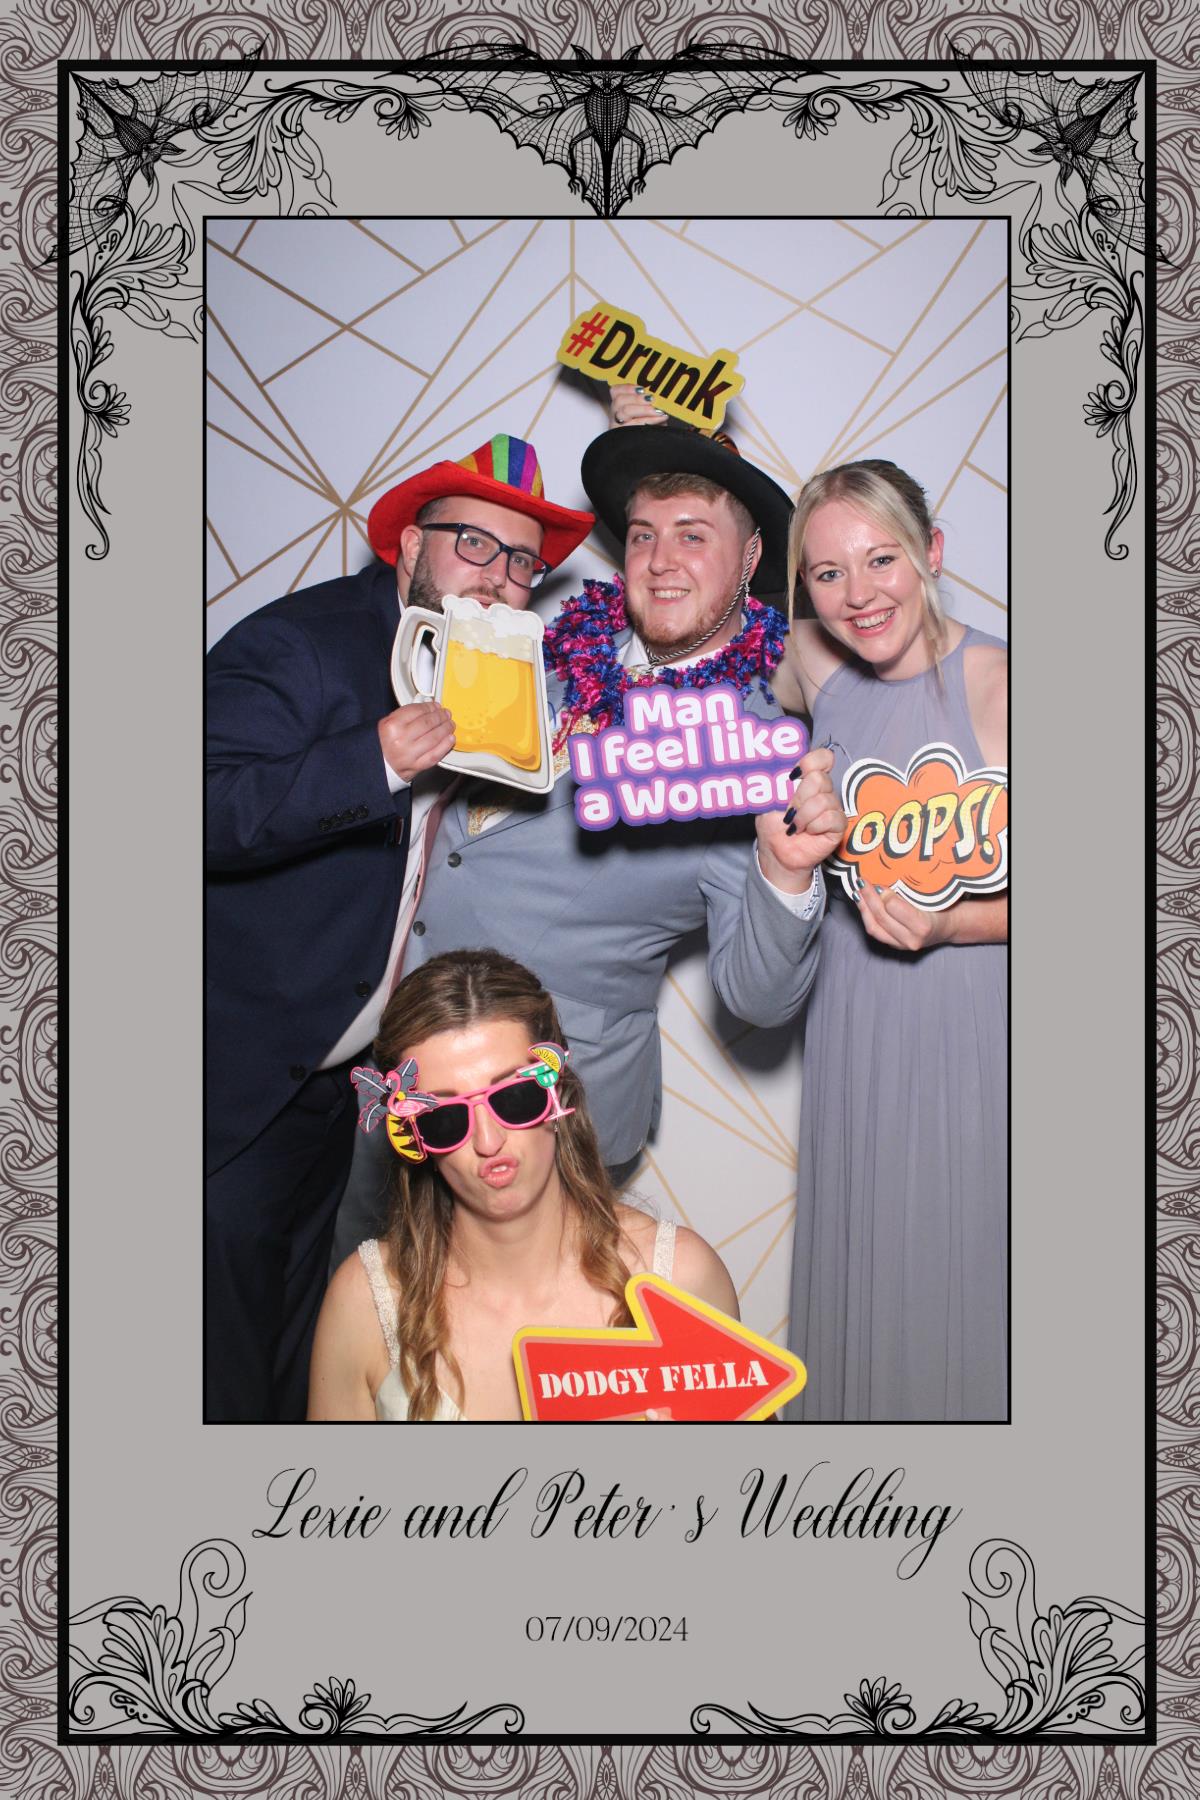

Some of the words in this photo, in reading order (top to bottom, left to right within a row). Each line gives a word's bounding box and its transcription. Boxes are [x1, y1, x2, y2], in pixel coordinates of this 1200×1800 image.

[565, 312, 732, 420] #Drunk
[633, 693, 735, 732] Man
[577, 742, 592, 777] I
[604, 728, 699, 774] feel
[711, 719, 800, 762] like
[583, 792, 610, 821] a
[621, 771, 798, 817] Woman
[847, 783, 1005, 864] OOPS!
[538, 1367, 649, 1399] DODGY
[659, 1360, 769, 1392] FELLA
